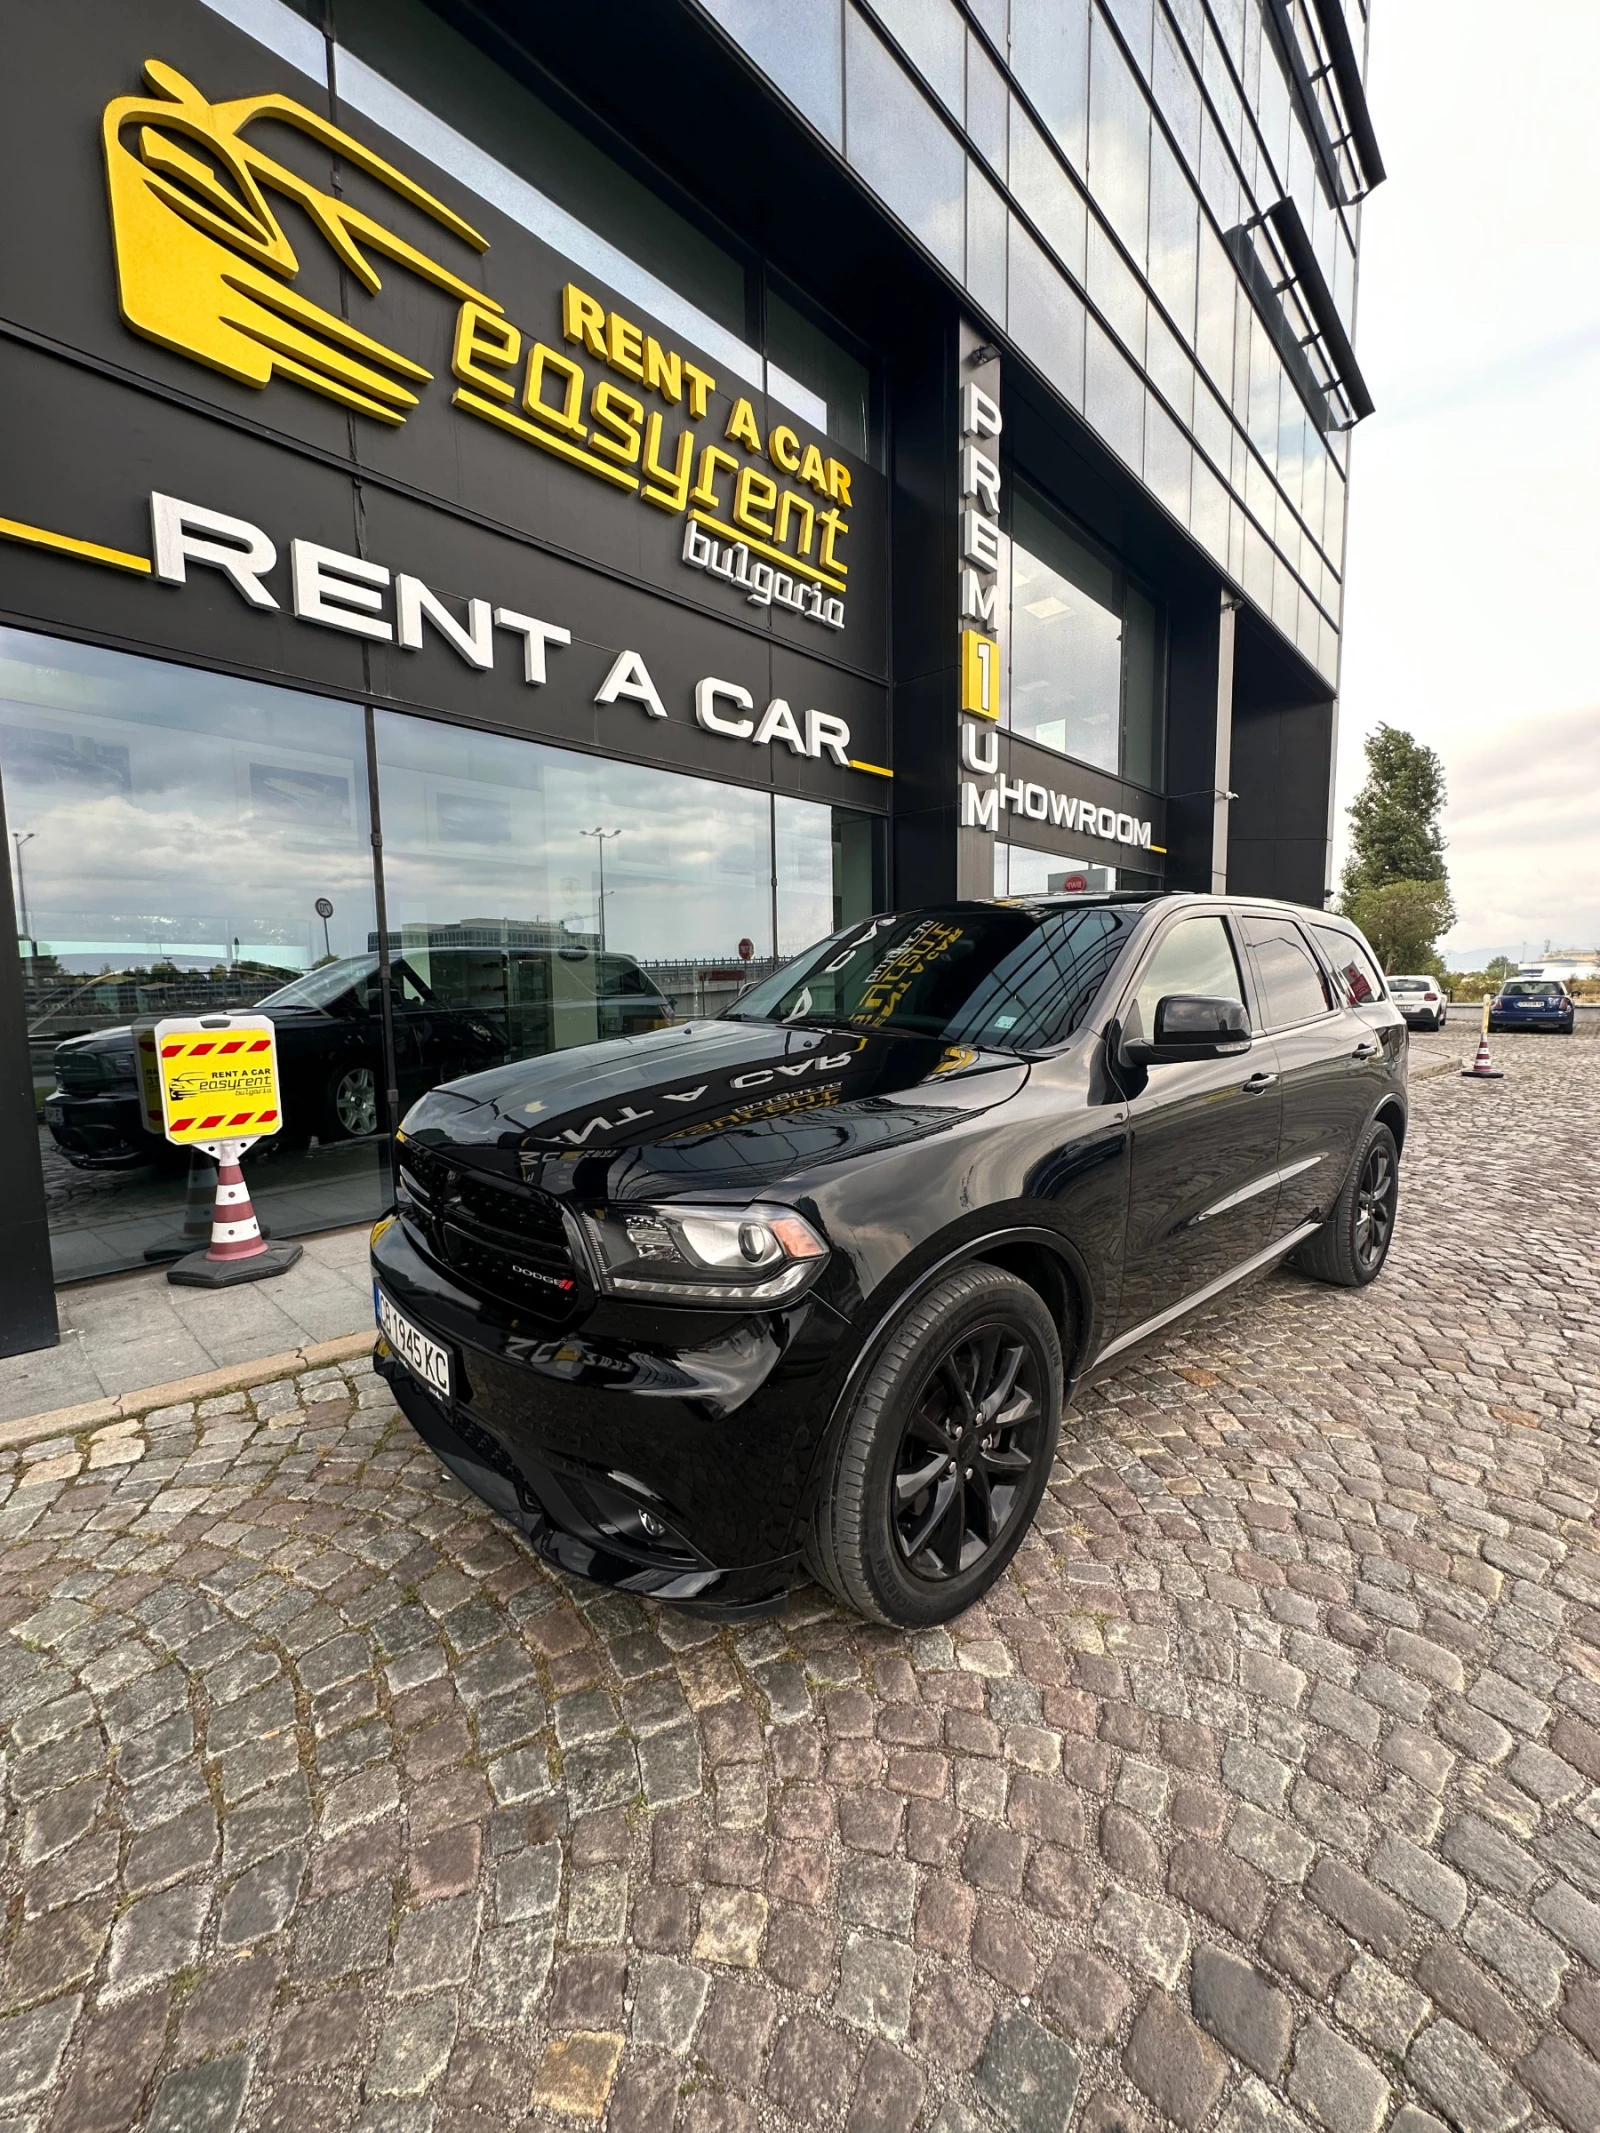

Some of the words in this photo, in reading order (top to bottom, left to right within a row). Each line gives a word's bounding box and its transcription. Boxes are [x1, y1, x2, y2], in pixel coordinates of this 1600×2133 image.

[562, 283, 716, 420] RENT
[725, 397, 762, 453] A
[768, 425, 853, 508] CAR
[452, 301, 848, 575] easyrent
[682, 520, 846, 629] bulgaria
[150, 491, 571, 685] RENT
[596, 649, 667, 718] A
[694, 677, 852, 767] CAR
[998, 772, 1152, 850] HOWROOM
[199, 1076, 272, 1091] easyrent
[211, 1070, 239, 1079] RENT
[241, 1069, 249, 1077] A
[251, 1068, 271, 1076] CAR
[234, 1087, 272, 1096] bulgaria
[512, 1265, 563, 1287] DODGE
[393, 1312, 422, 1368] 1945
[424, 1341, 447, 1389] KC
